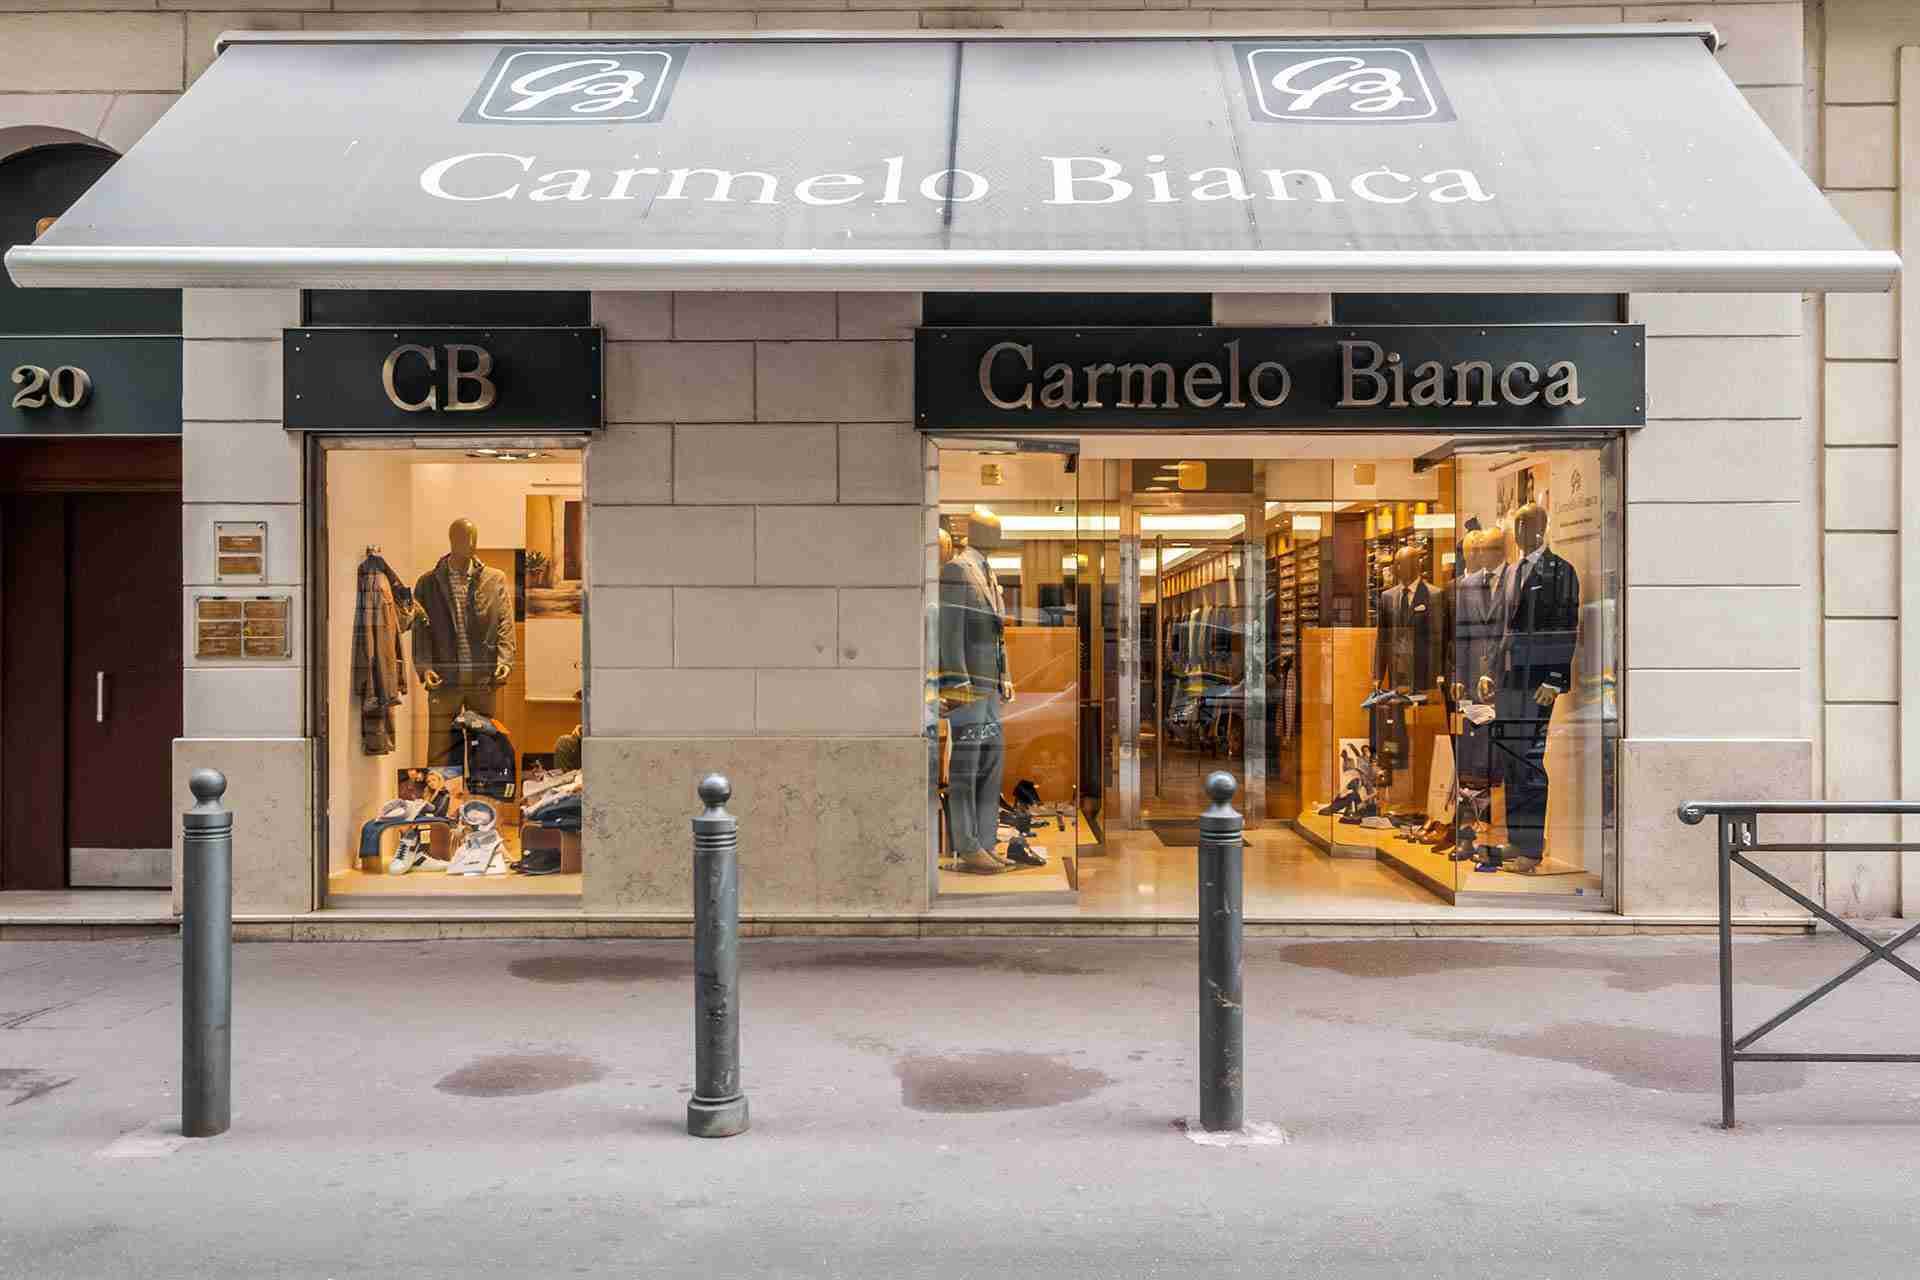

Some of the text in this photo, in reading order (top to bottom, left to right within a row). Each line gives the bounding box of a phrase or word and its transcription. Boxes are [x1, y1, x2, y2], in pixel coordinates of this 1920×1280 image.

[420, 153, 1495, 205] Carmelo Bianca
[11, 364, 92, 409] 20
[382, 344, 497, 411] CB
[978, 338, 1586, 410] Carmelo Bianca
